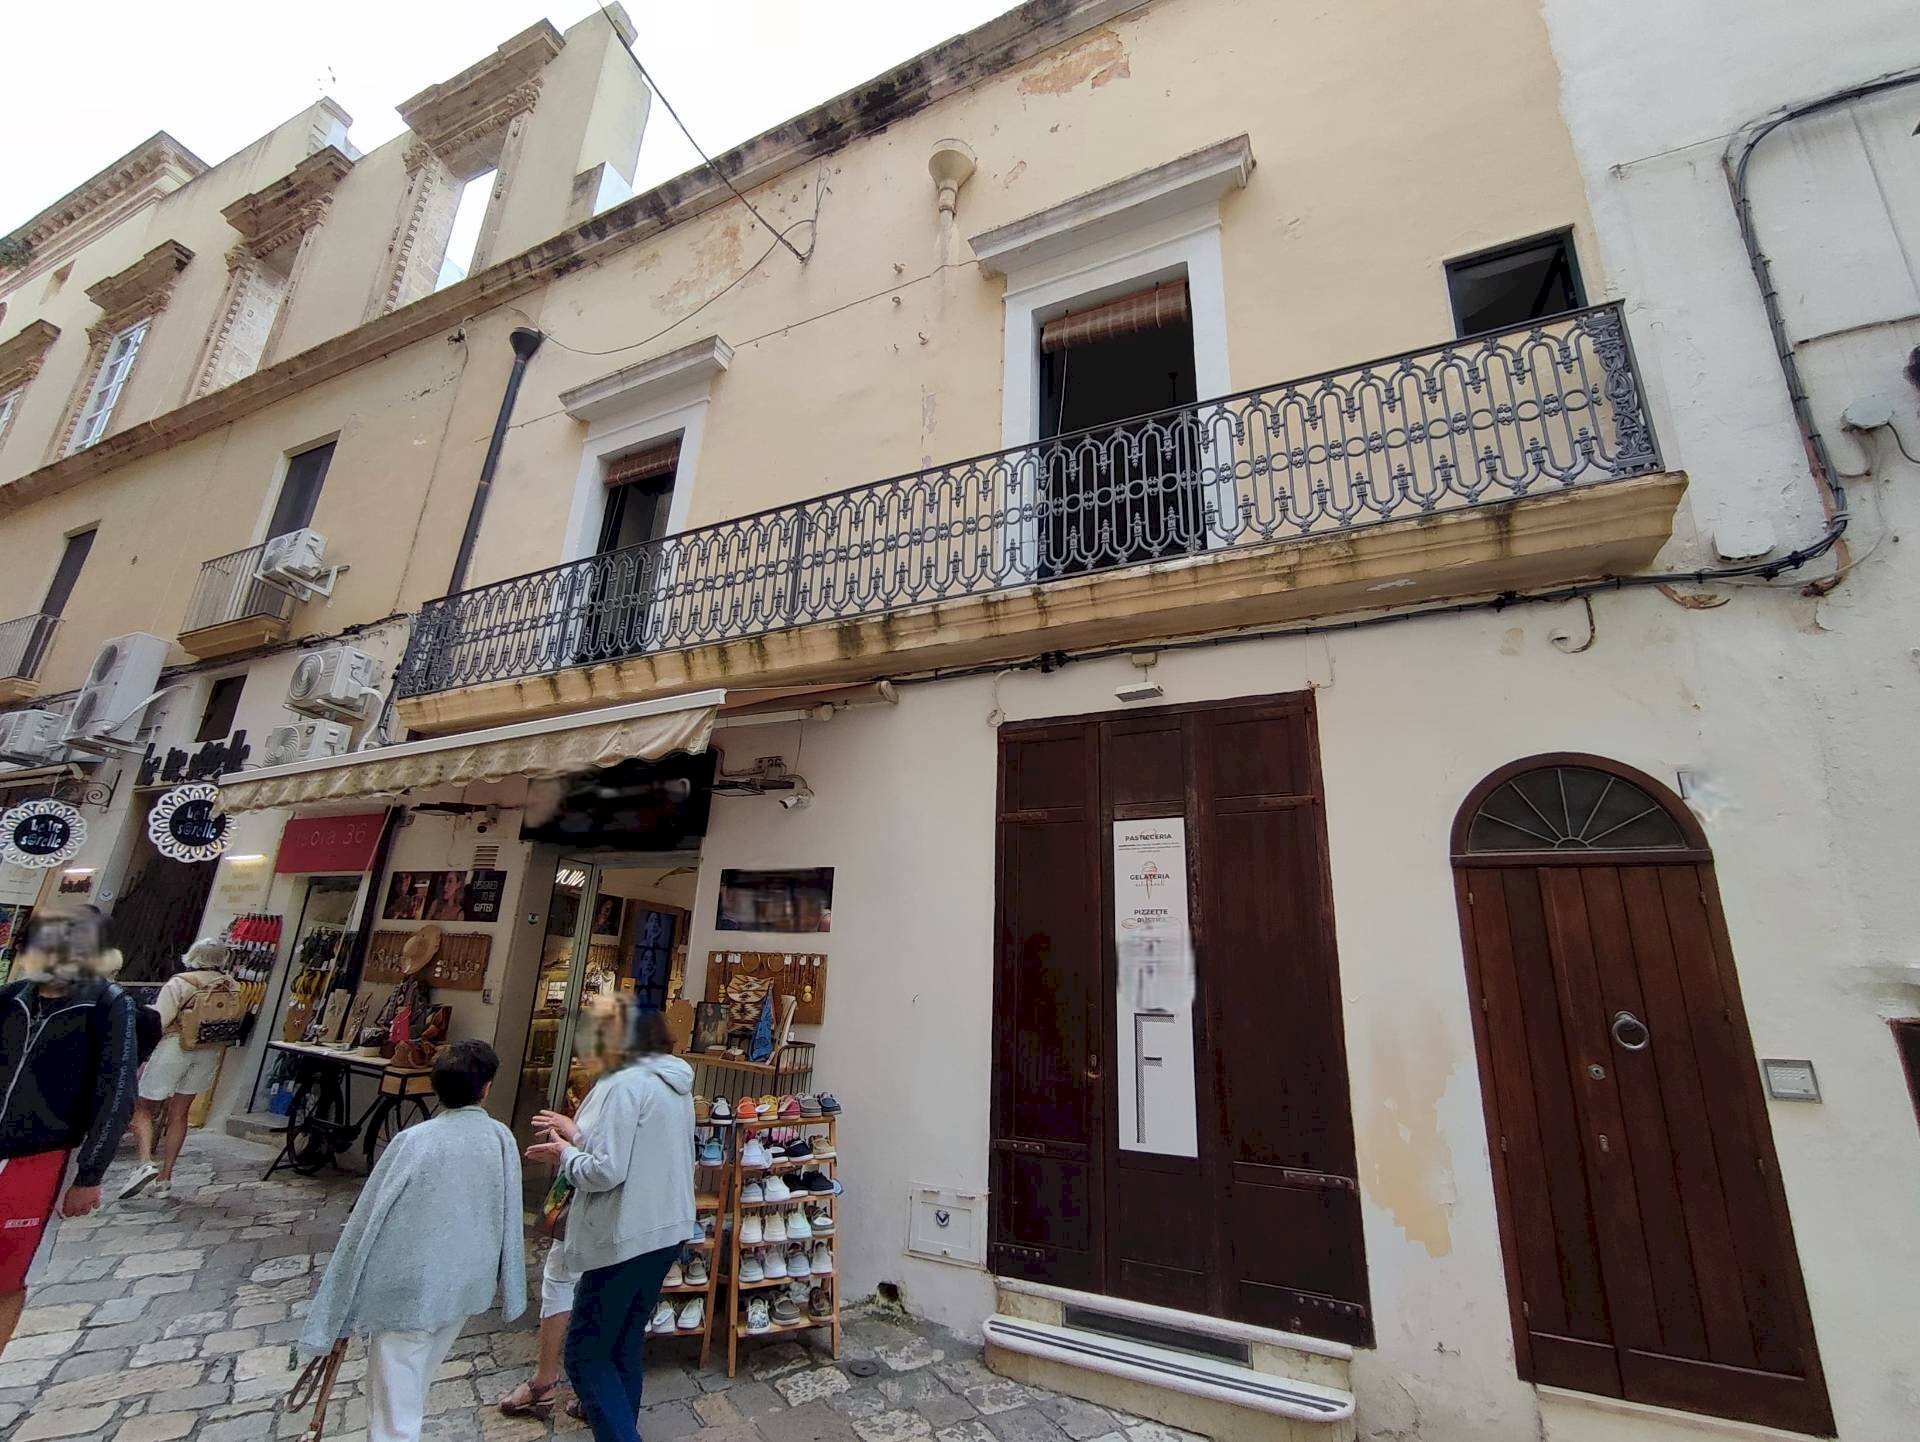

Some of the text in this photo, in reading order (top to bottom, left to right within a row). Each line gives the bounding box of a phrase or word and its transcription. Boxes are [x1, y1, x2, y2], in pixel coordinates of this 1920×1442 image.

[343, 823, 367, 844] 36
[1129, 873, 1170, 881] GELATERIA
[1134, 908, 1168, 916] PIZZETTE
